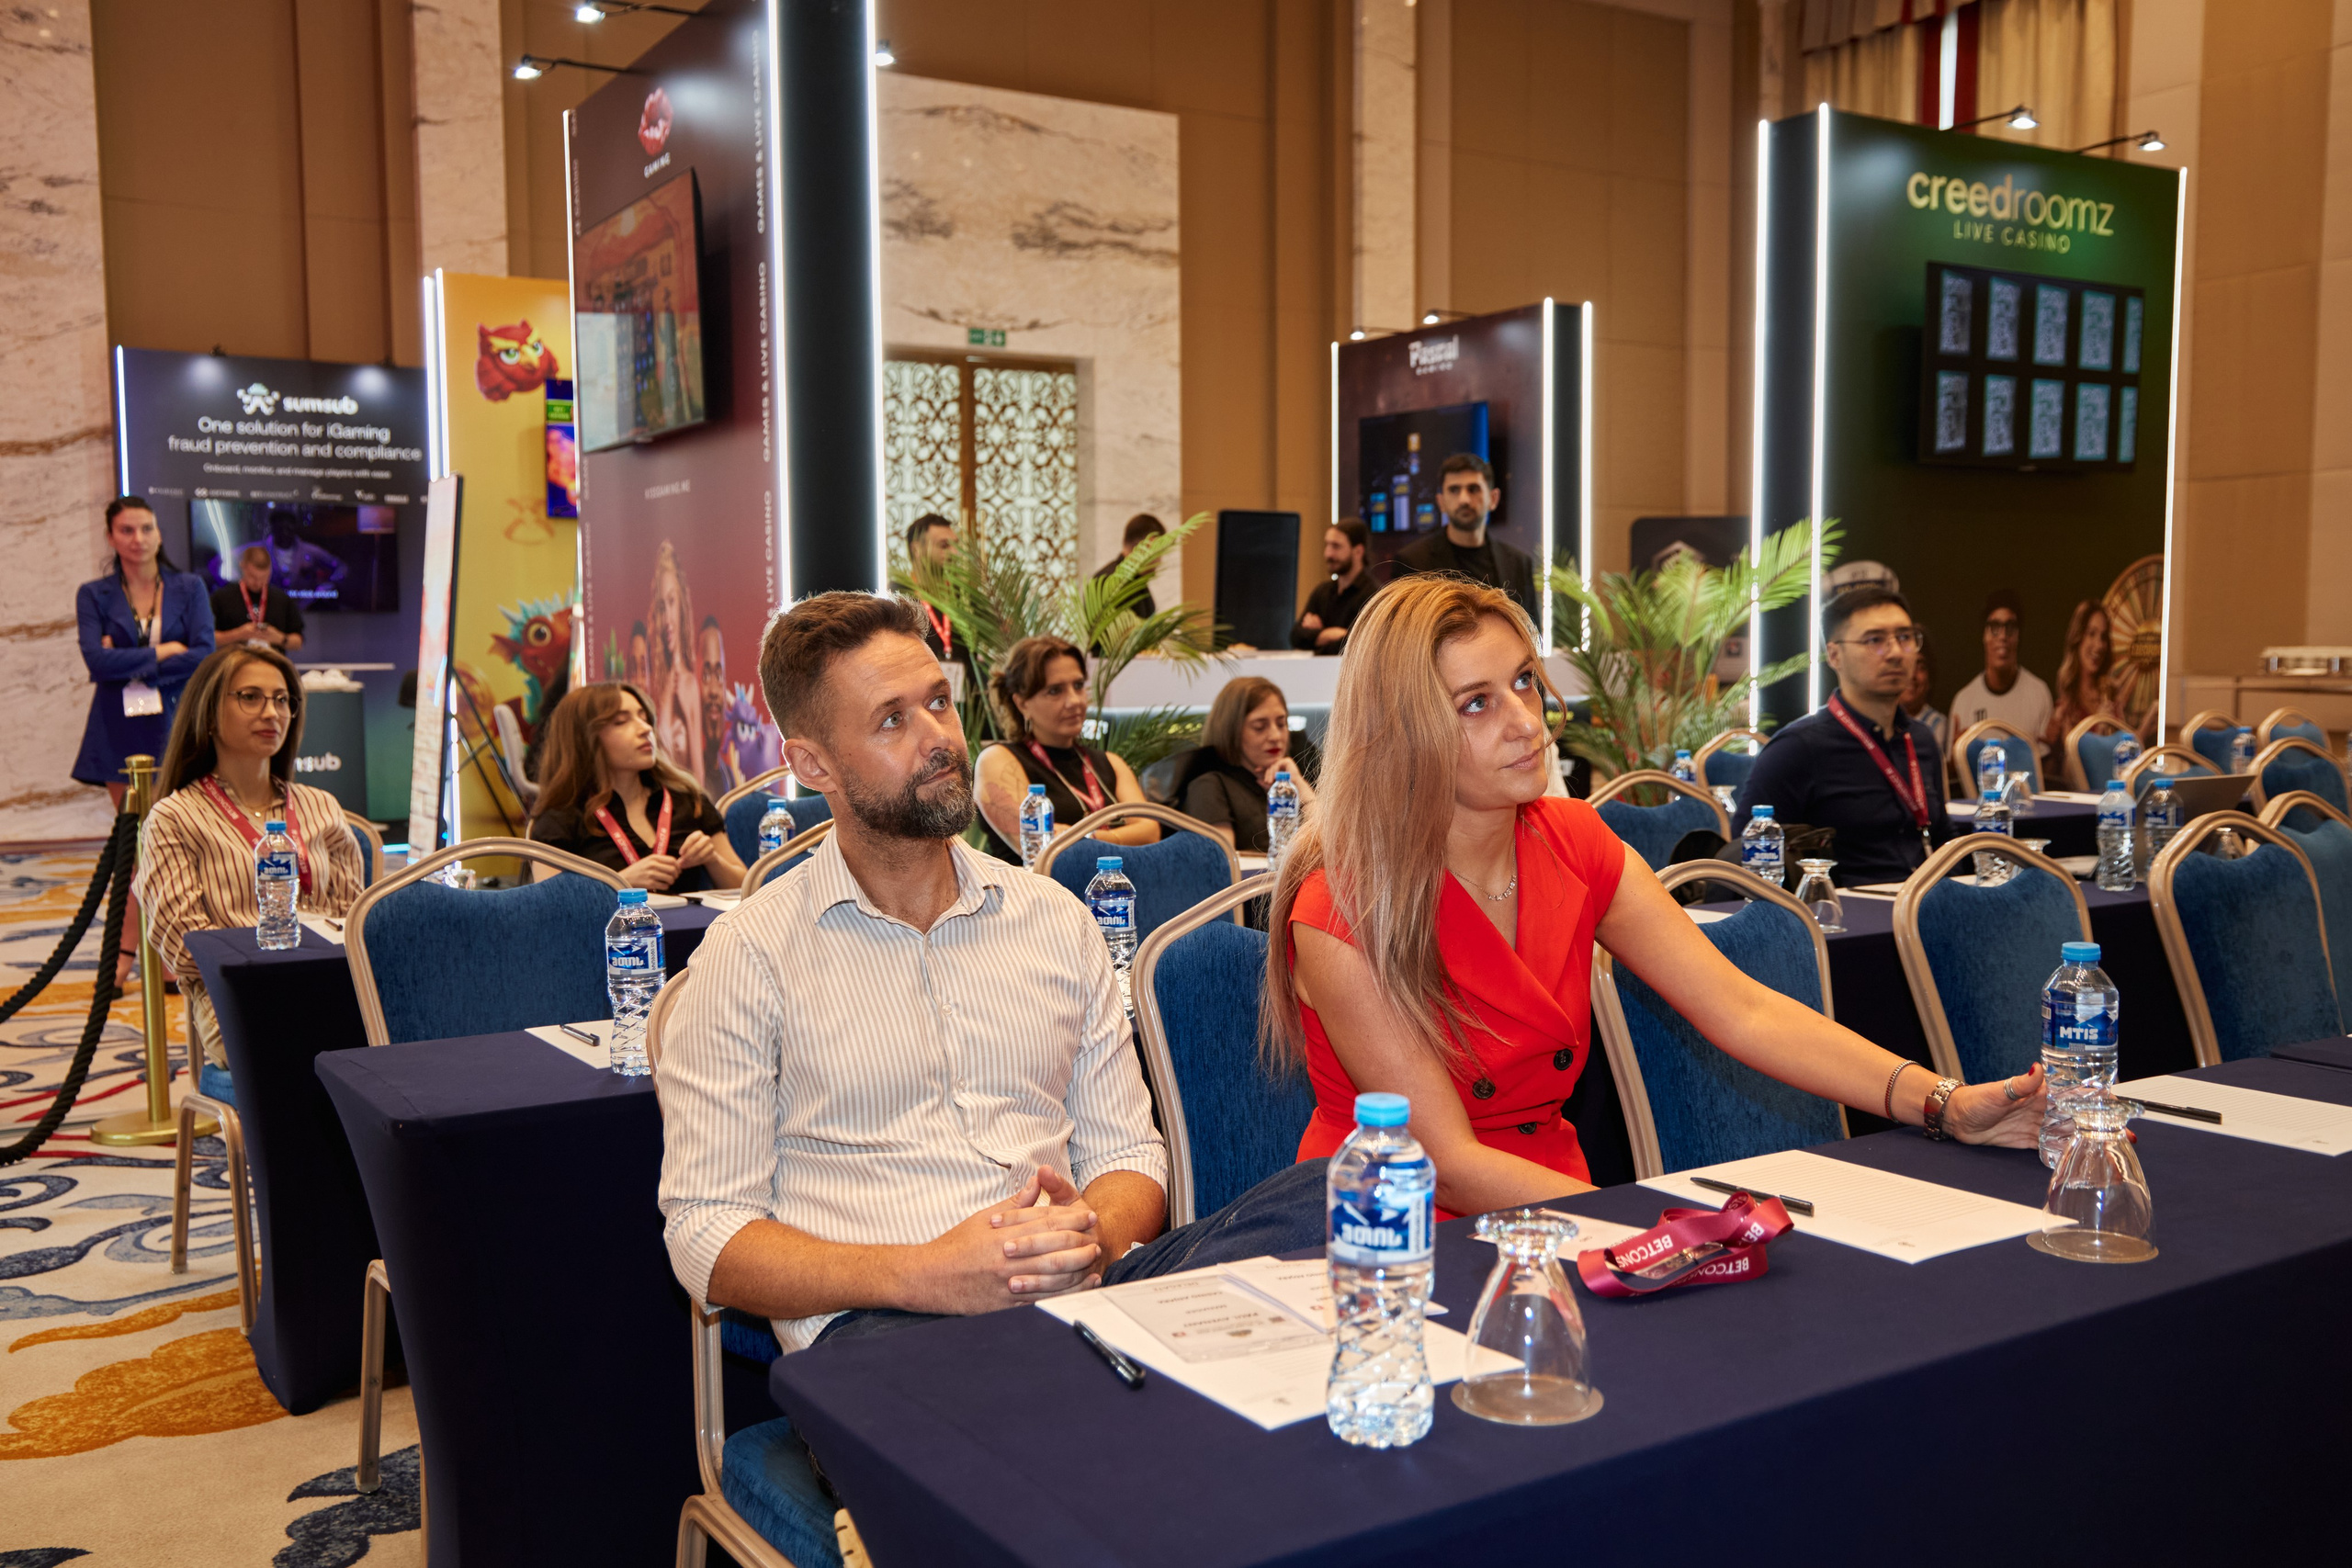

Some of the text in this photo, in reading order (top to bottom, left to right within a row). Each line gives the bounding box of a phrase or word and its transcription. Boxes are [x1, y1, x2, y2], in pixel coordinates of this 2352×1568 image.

[752, 30, 765, 234] GAMES & LIVE CASINO
[1906, 172, 2114, 236] creedroomz
[1953, 220, 2071, 254] LIVE CASINO
[758, 262, 771, 463] GAMES & LIVE CASINO
[283, 396, 358, 415] sumsub
[168, 435, 423, 462] fraud prevention and compliance
[198, 416, 391, 445] One solution for iGaming
[763, 490, 774, 562] CASINO
[765, 565, 775, 604] LIVE
[2060, 1026, 2098, 1040] MTIS
